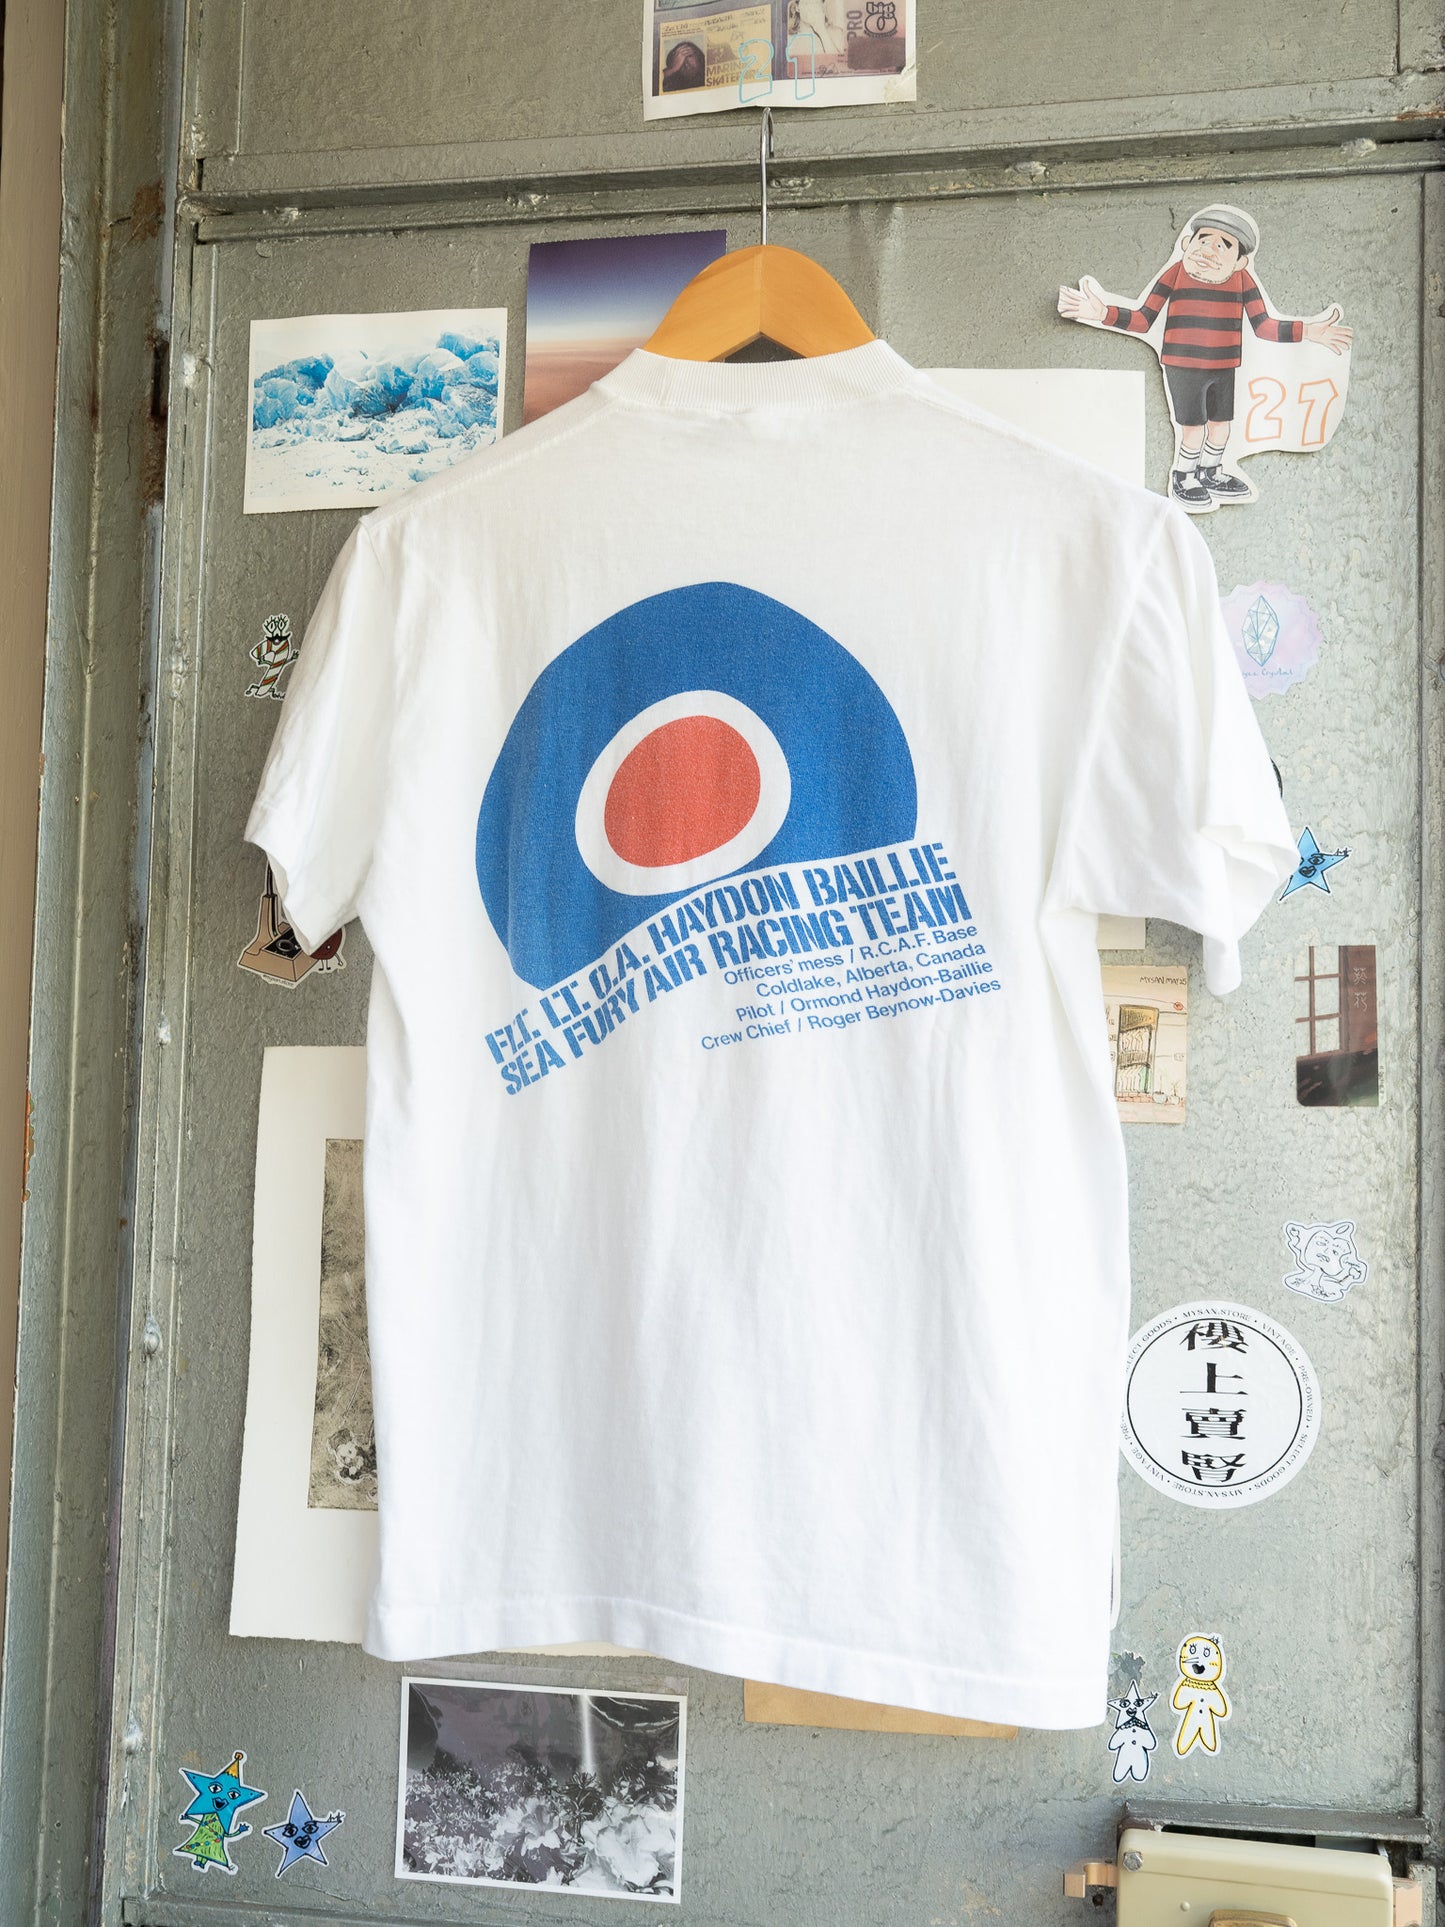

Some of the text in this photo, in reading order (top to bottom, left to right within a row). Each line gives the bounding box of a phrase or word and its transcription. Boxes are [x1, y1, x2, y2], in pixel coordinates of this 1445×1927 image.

[846, 10, 863, 42] PRO
[738, 33, 815, 103] 21
[1245, 376, 1339, 446] 27
[539, 980, 592, 1029] LT.
[647, 872, 800, 954] HAYDON
[802, 842, 957, 907] BAILLIE
[799, 953, 844, 972] mess
[860, 933, 931, 961] R.C.A.F.
[933, 924, 978, 945] Base
[501, 883, 973, 1096] SEA FURY AIR RACING TEAM
[736, 1004, 775, 1022] Pilot
[790, 989, 862, 1013] Ormond
[867, 960, 993, 1001] Haydon-Baillie
[756, 942, 986, 998] Coldlake, Alberta, Canada
[701, 1031, 743, 1050] Crew
[746, 1019, 791, 1040] Chief
[807, 1012, 862, 1034] Roger
[867, 977, 1002, 1020] Beynow-Davies
[1142, 1318, 1172, 1342] GOODS
[1183, 1308, 1251, 1320] MYSAN.STORE
[1262, 1323, 1296, 1356] VINTAGE
[1299, 1365, 1313, 1421] PRE-OWNED
[1254, 1433, 1308, 1488] SELECT GOODS
